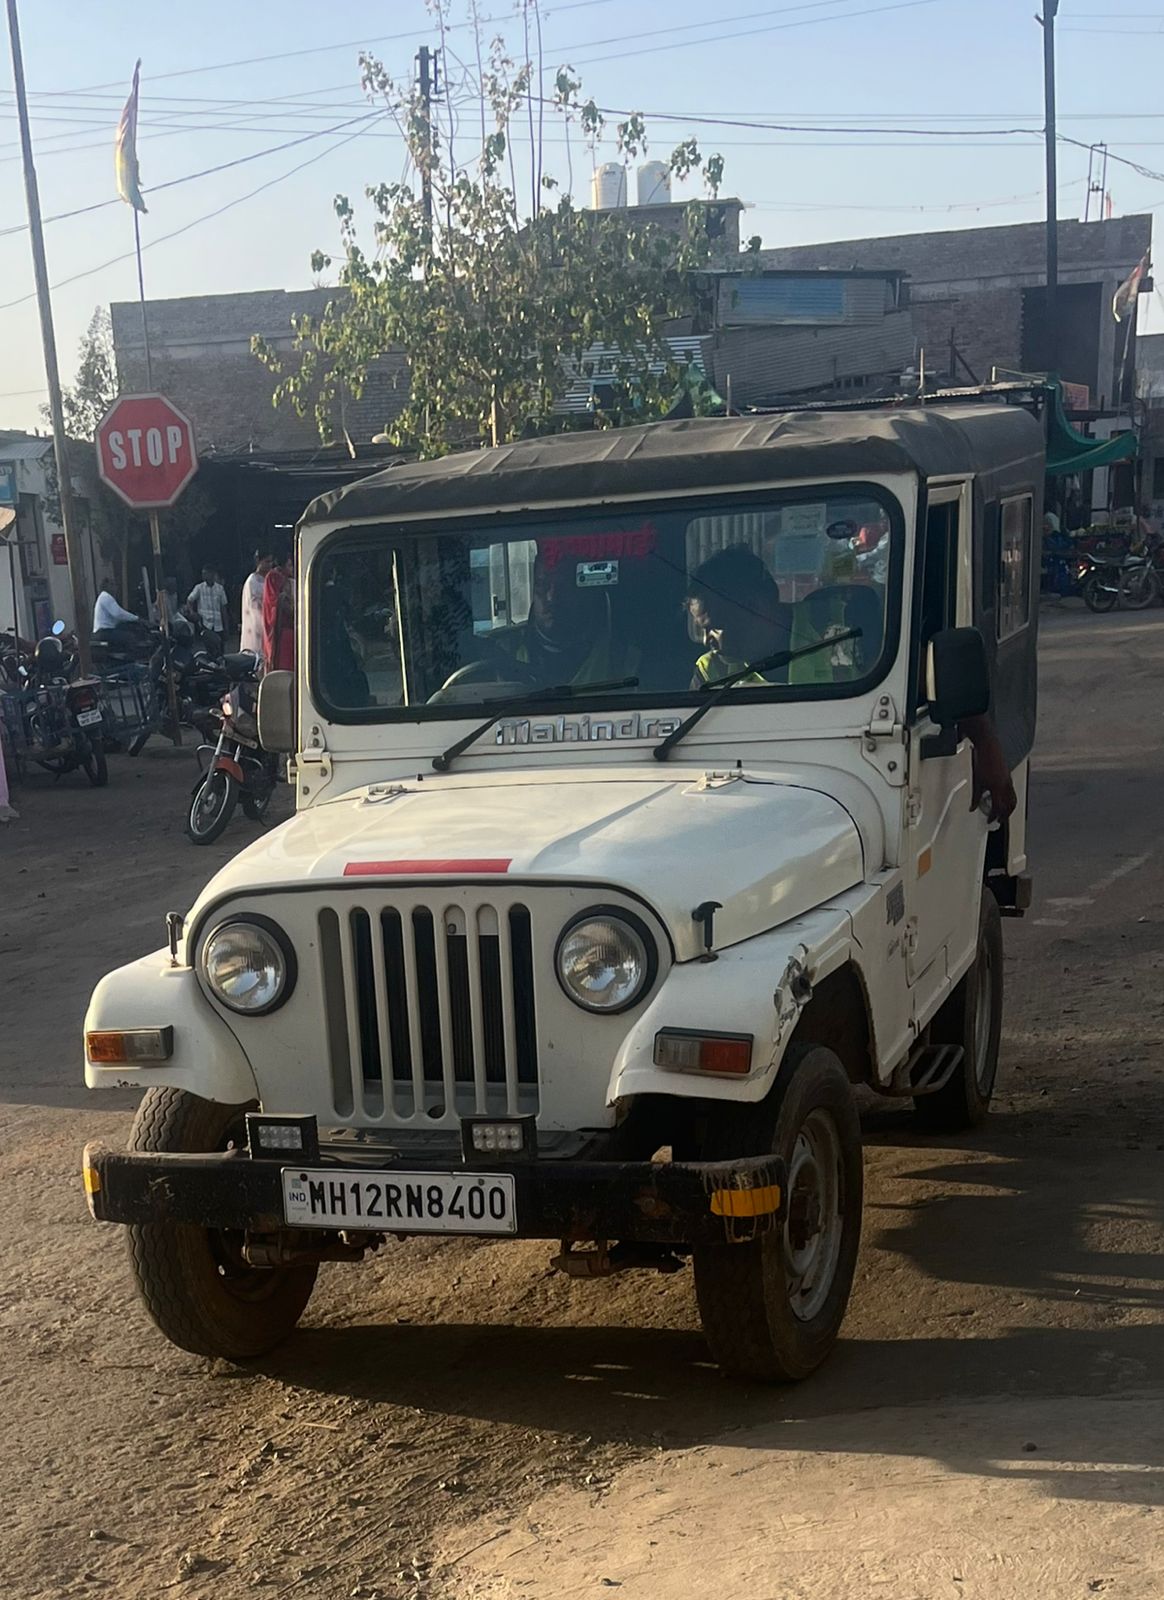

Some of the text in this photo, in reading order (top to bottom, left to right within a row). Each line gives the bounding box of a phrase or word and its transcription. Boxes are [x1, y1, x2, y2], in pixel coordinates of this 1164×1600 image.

[108, 425, 182, 470] STOP
[495, 712, 682, 745] Mahindra
[288, 1191, 306, 1202] IND
[308, 1180, 506, 1220] MH12RN8400
